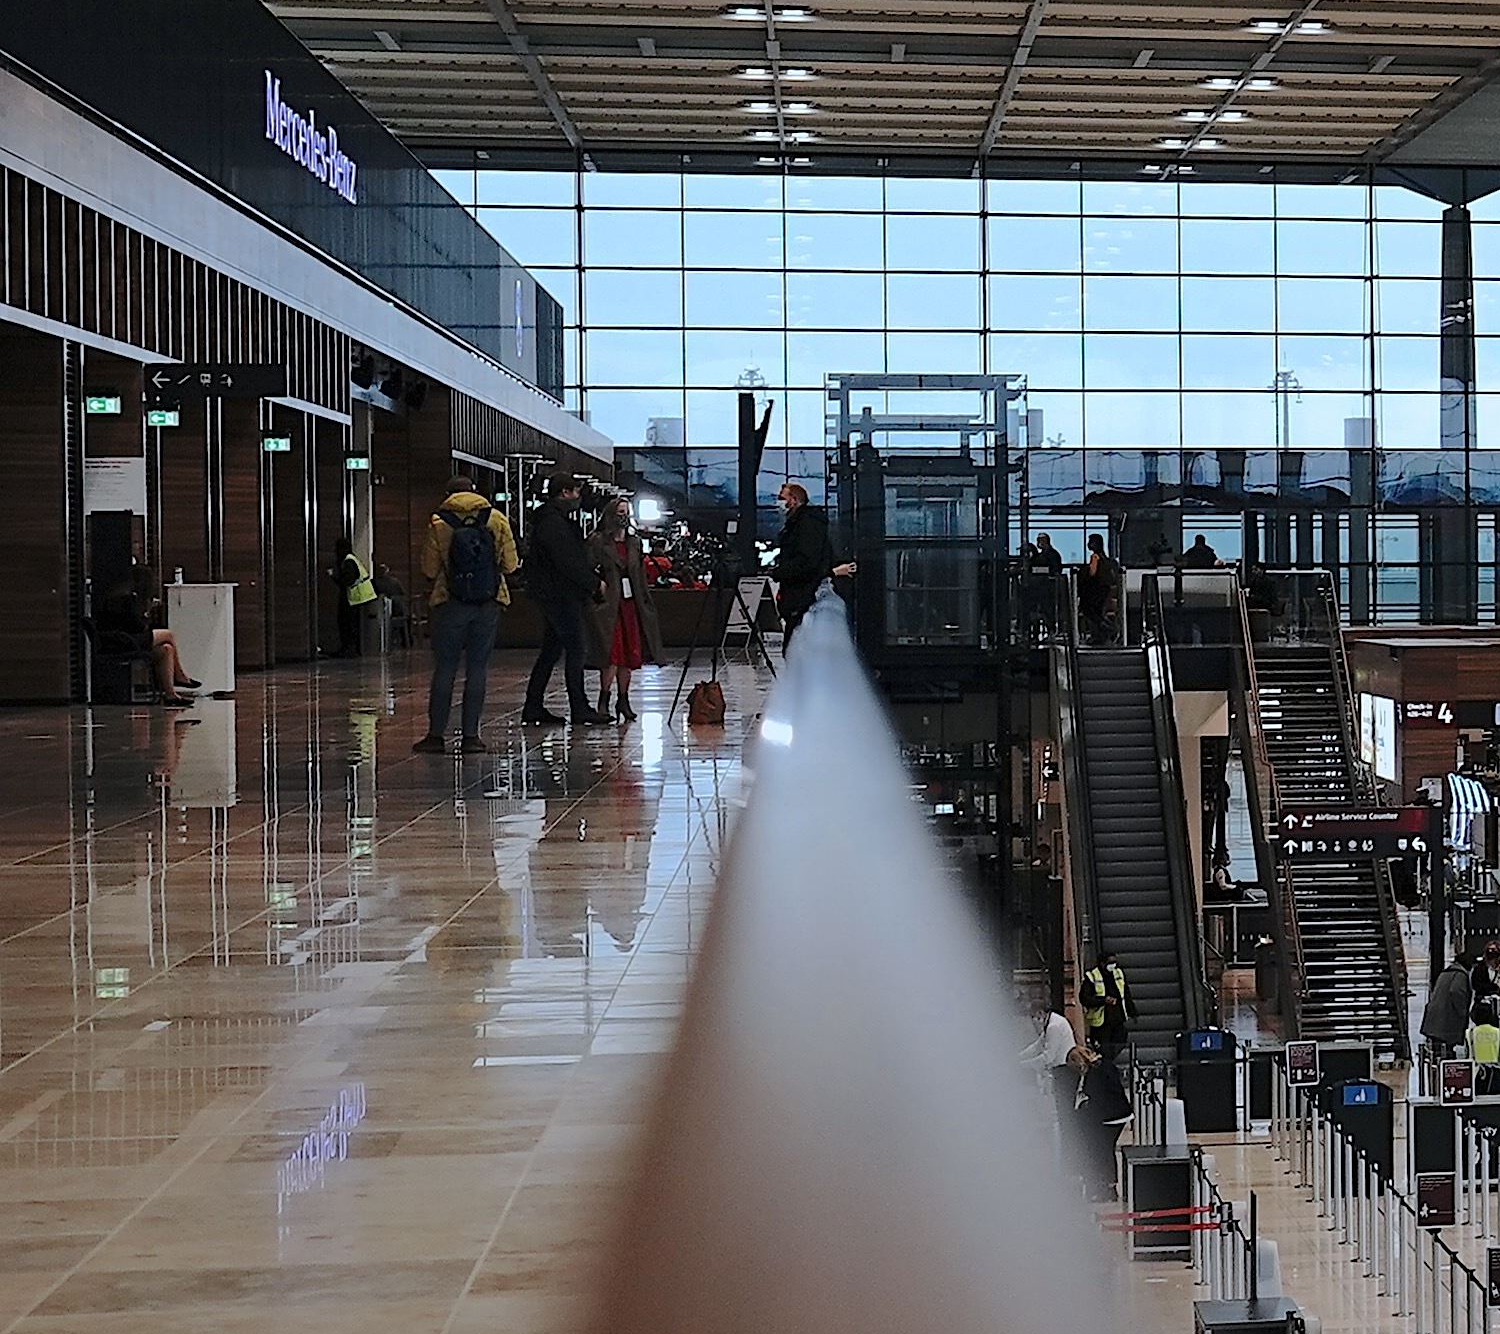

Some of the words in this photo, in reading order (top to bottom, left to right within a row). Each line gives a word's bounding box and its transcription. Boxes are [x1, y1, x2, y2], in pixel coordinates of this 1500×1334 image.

[265, 70, 357, 205] Mercedes-Benz
[1437, 702, 1454, 724] 4
[1315, 813, 1340, 821] Airline
